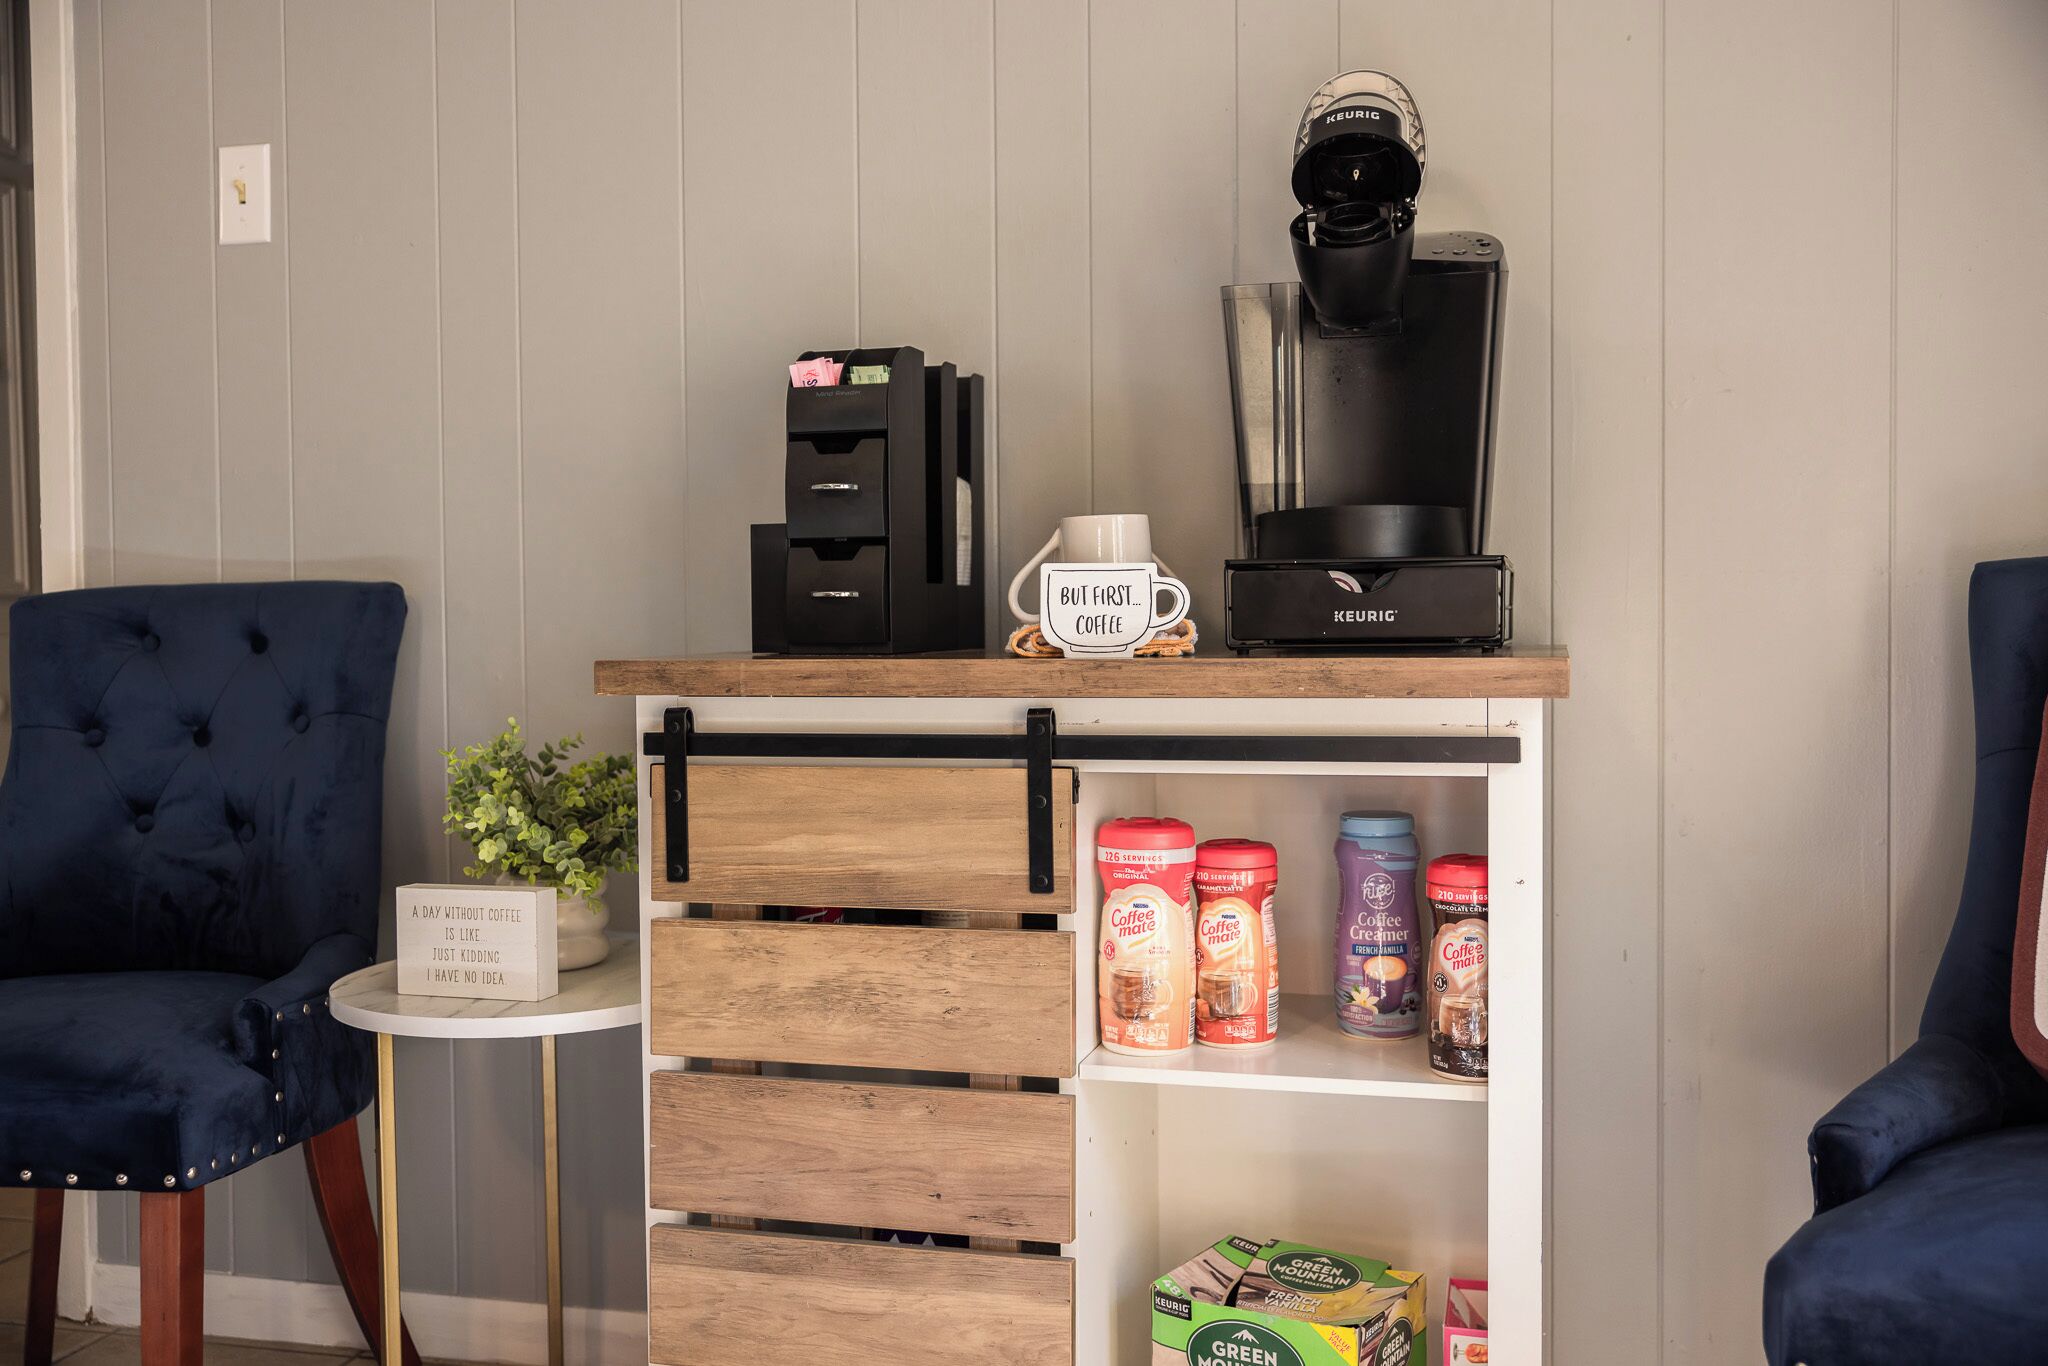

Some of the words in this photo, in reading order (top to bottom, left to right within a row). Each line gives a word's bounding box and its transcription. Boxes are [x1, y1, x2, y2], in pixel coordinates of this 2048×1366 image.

[1326, 110, 1380, 124] KEURIG
[1060, 584, 1089, 606] BUT
[1093, 584, 1142, 606] FIRST...
[1334, 610, 1396, 622] KEURIG
[1076, 614, 1123, 636] COFFEE
[1105, 851, 1120, 862] 226
[1122, 854, 1163, 862] SERVINGS
[1196, 871, 1209, 880] 210
[1210, 874, 1245, 882] SERVINGS
[1196, 884, 1224, 892] CARAMEL
[1438, 890, 1453, 900] 210
[412, 905, 419, 918] A
[422, 906, 442, 919] DAY
[444, 906, 485, 921] WITHOUT
[488, 908, 522, 923] COFFEE
[1434, 904, 1468, 912] CHOCOLATE
[1111, 909, 1156, 928] Coffee
[1357, 912, 1402, 927] Coffee
[445, 928, 455, 941] IS
[1118, 920, 1156, 938] mate
[1201, 920, 1240, 936] Coffee
[1349, 926, 1409, 942] Creamer
[1208, 930, 1241, 946] mate
[432, 948, 456, 962] JUST
[1355, 945, 1378, 955] FRENCH
[1379, 946, 1404, 955] VANILLA
[1443, 942, 1484, 961] Coffee
[1452, 954, 1486, 971] mate
[435, 969, 459, 983] HAVE
[464, 970, 477, 984] NO
[482, 972, 507, 986] IDEA.
[1272, 1264, 1352, 1286] MOUNTAIN
[1291, 1258, 1344, 1276] GREEN
[1280, 1274, 1304, 1284] COFFEE
[1304, 1280, 1334, 1290] ROASTERS
[1155, 1296, 1190, 1313] KEURIG
[1264, 1296, 1317, 1314] VANILLA
[1268, 1290, 1324, 1307] FRENCH
[1366, 1318, 1384, 1340] KEURIG
[1328, 1336, 1346, 1355] PACK
[1331, 1330, 1352, 1351] VALUE
[1382, 1332, 1405, 1360] GREEN
[1211, 1340, 1278, 1366] GREEN
[1380, 1340, 1411, 1366] OUNTAIN
